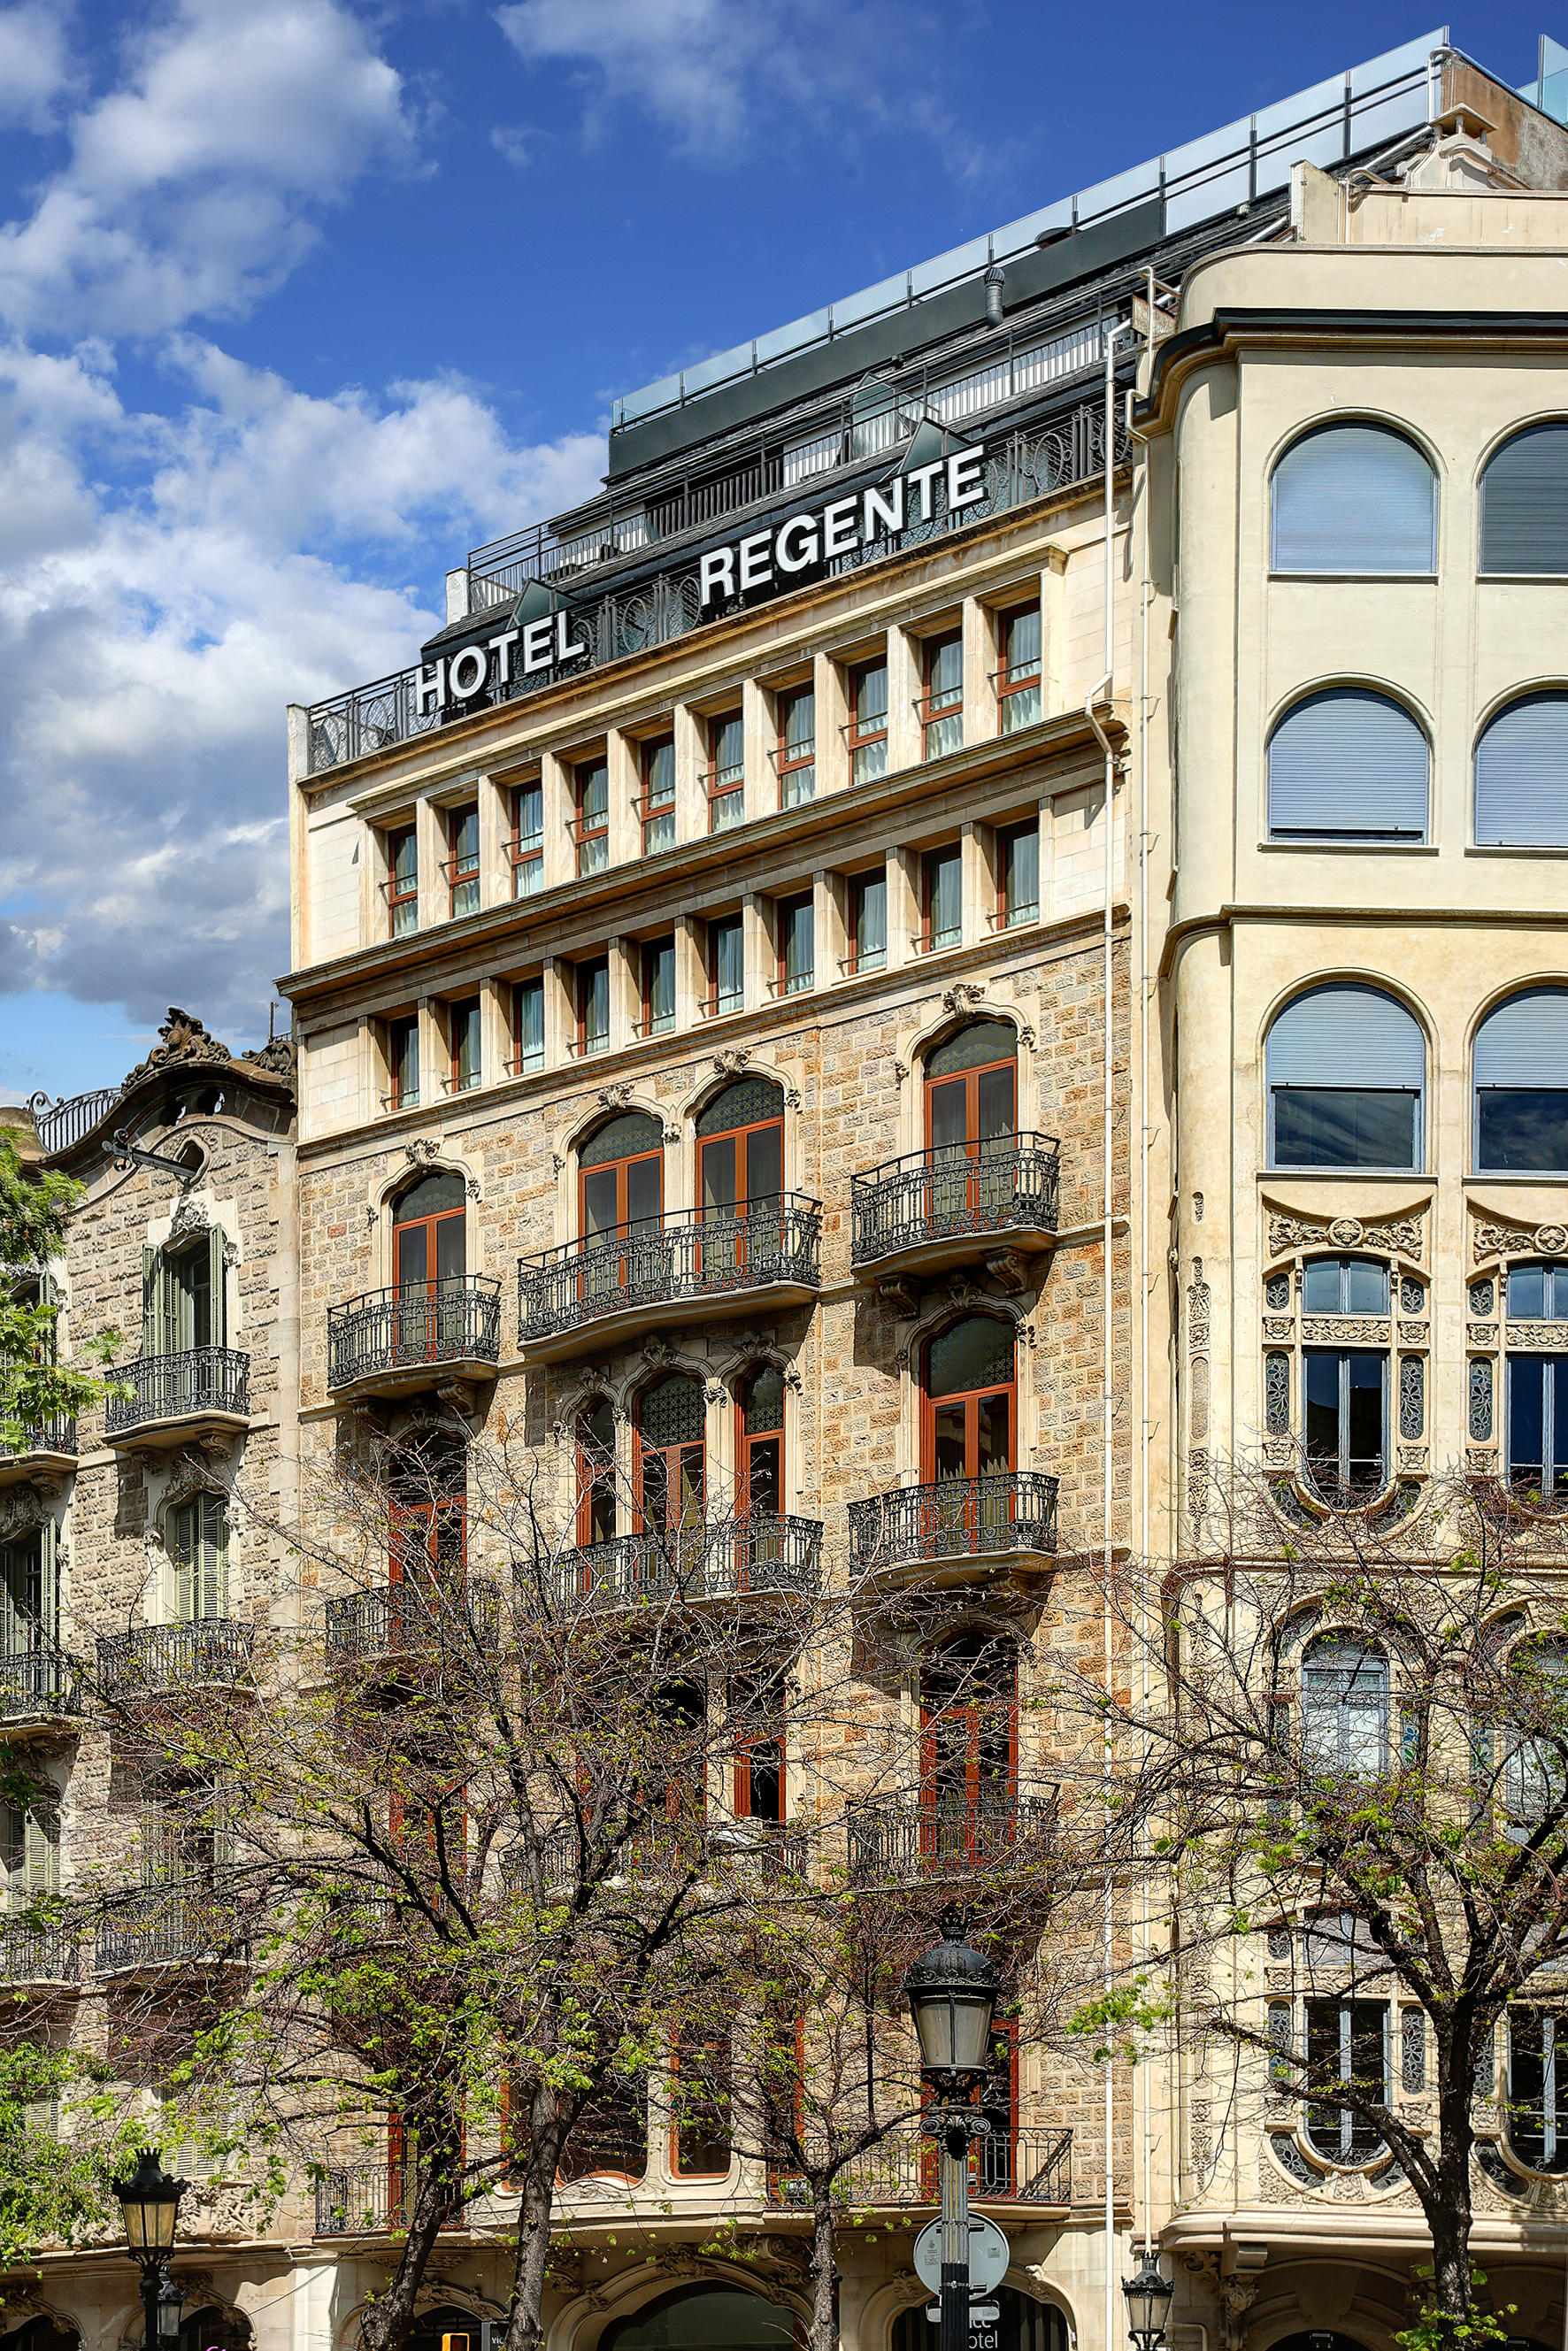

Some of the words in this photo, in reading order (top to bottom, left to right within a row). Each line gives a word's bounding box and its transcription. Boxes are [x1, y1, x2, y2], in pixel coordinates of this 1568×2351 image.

[415, 611, 586, 715] HOTEL
[700, 444, 988, 606] REGENTE
[968, 2330, 998, 2349] otel
